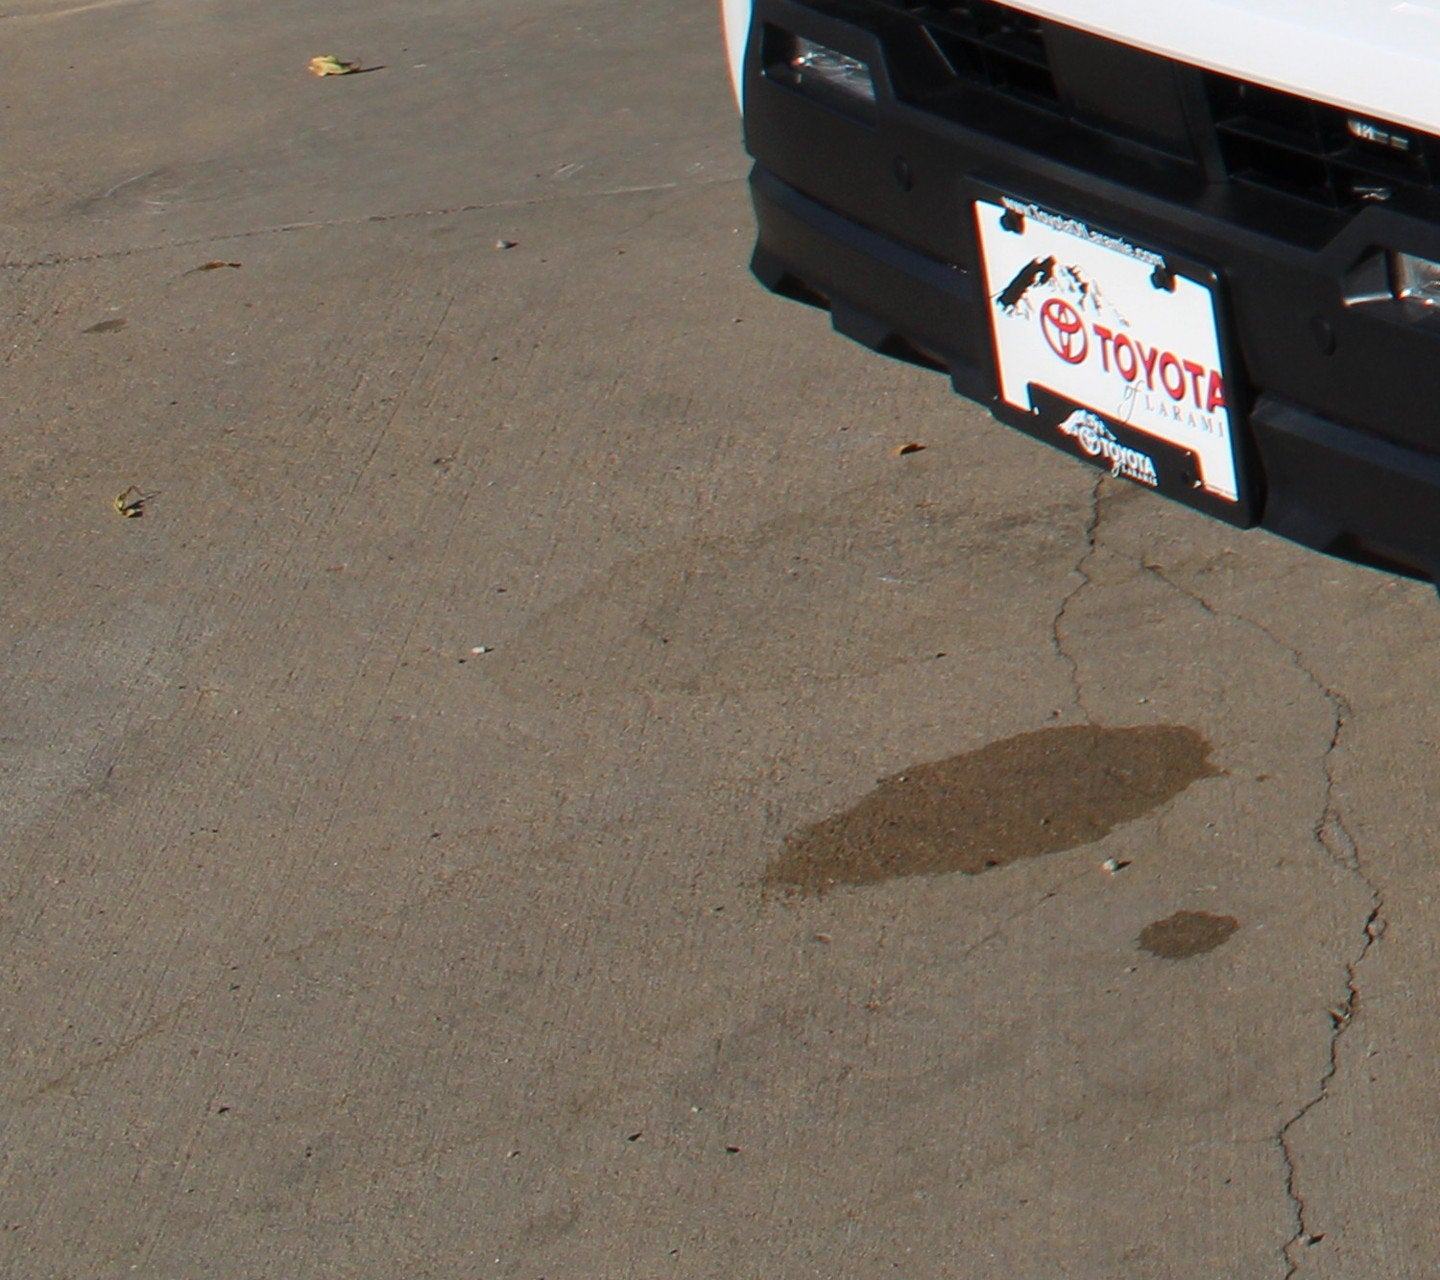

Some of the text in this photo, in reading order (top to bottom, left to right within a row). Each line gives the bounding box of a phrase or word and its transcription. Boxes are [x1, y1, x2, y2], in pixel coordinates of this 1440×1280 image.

[1092, 322, 1226, 414] TOYOTA
[1116, 379, 1146, 425] of
[1099, 437, 1157, 478] TOYOTA
